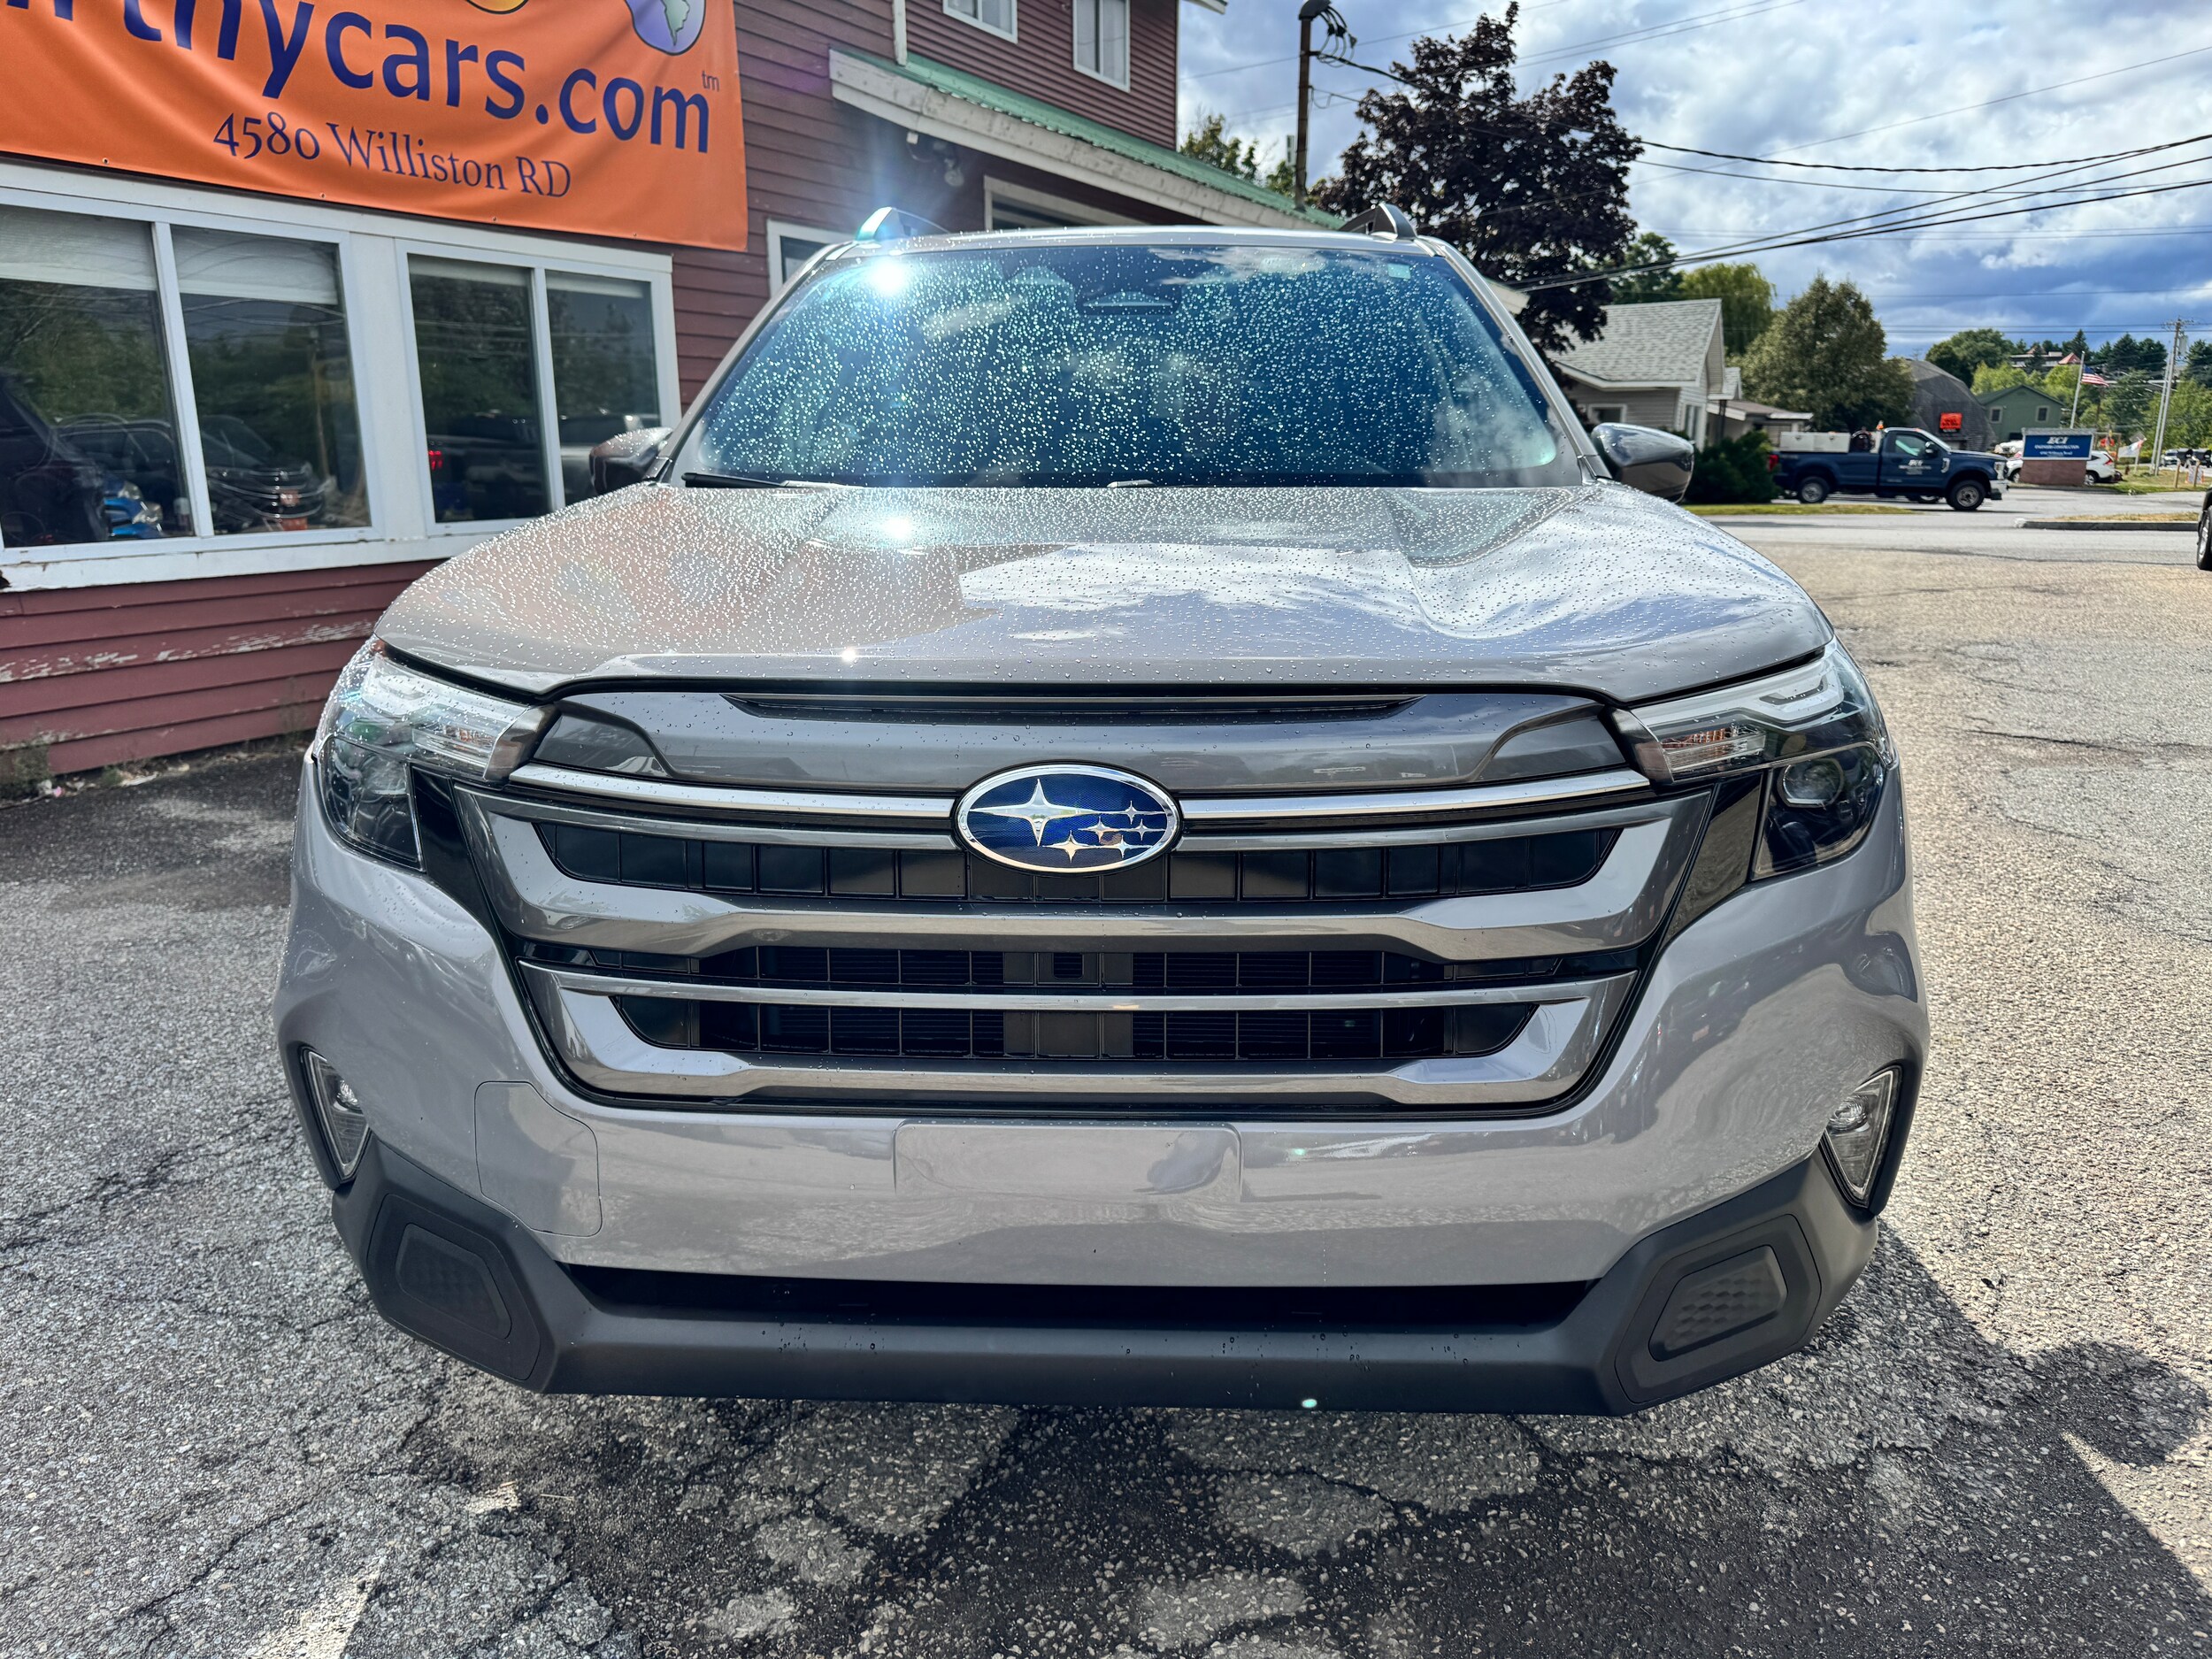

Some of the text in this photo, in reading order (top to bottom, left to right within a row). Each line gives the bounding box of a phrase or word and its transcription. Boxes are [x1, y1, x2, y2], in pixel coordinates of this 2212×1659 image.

[213, 111, 572, 198] 4580 Williston RD
